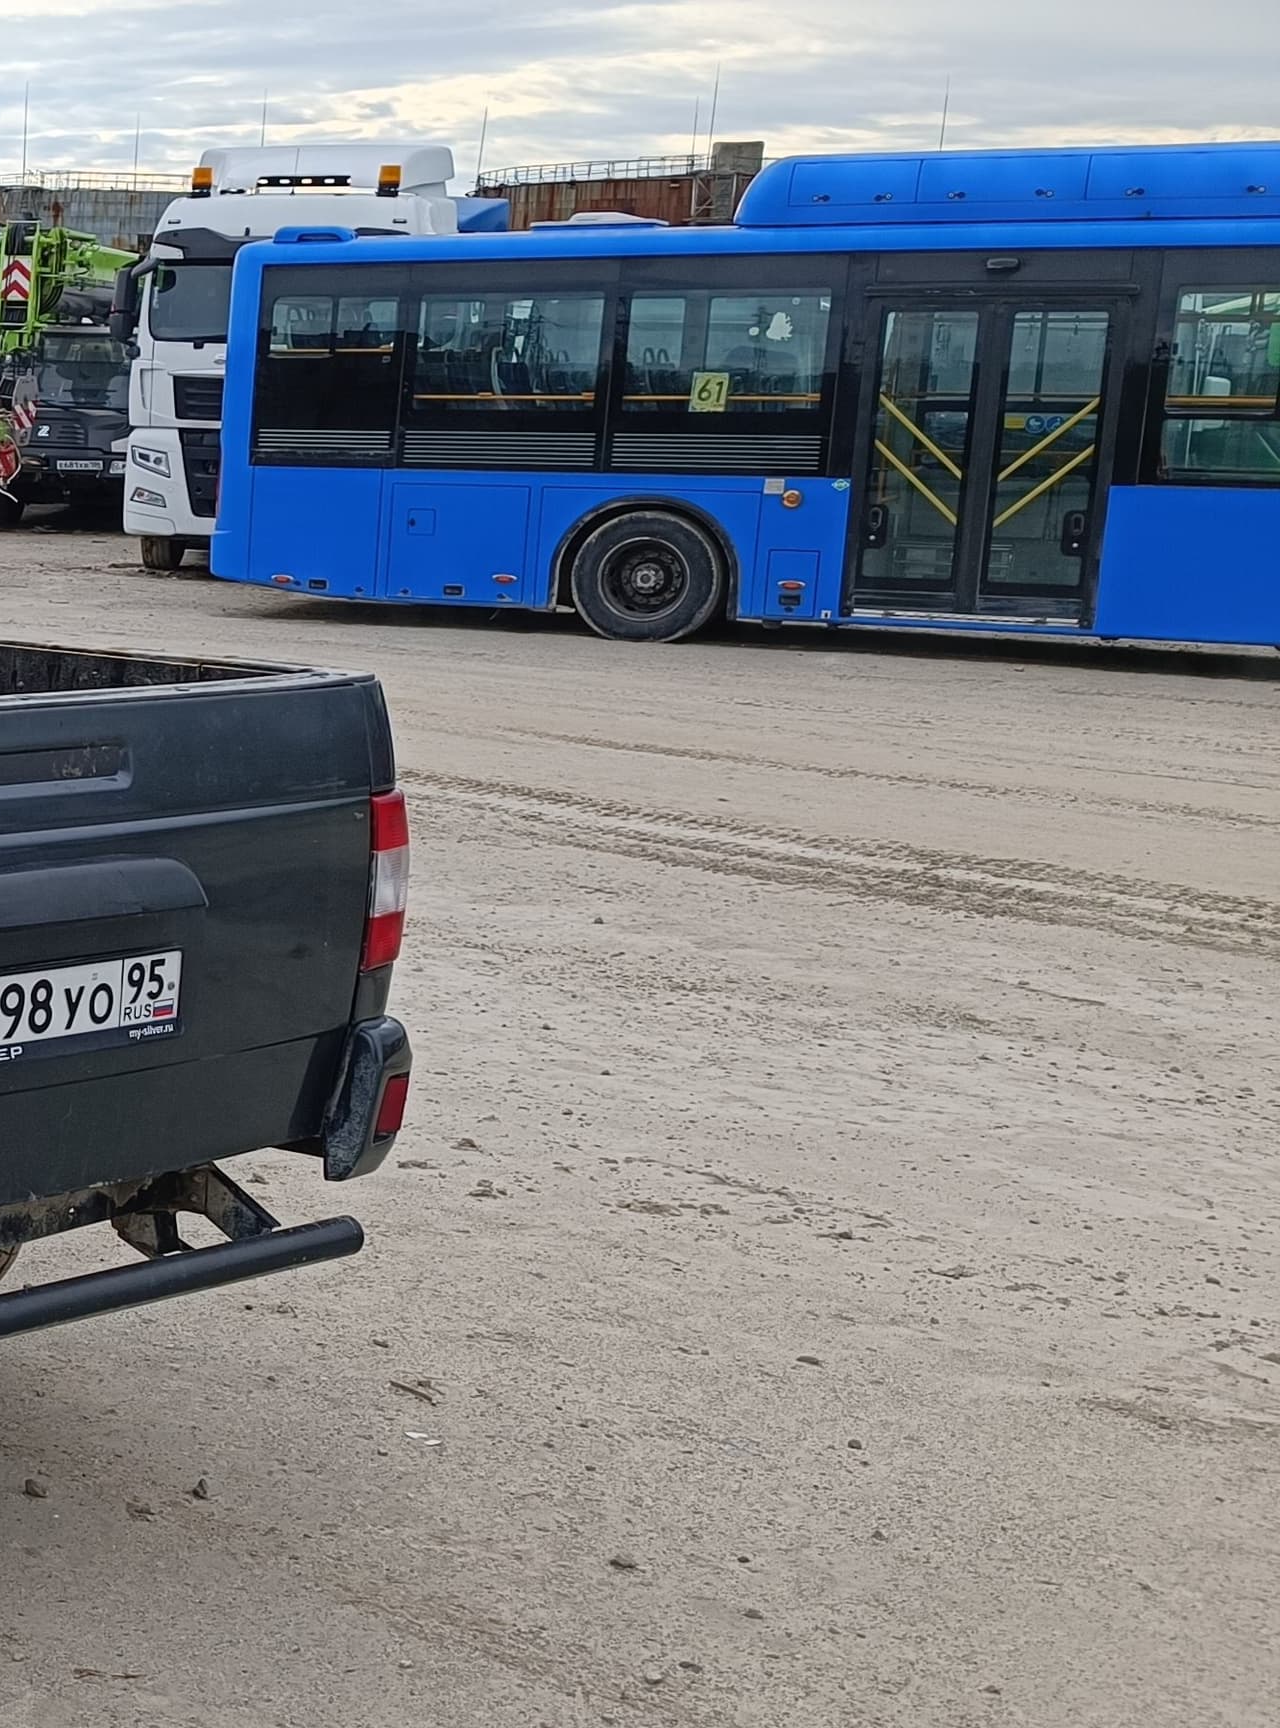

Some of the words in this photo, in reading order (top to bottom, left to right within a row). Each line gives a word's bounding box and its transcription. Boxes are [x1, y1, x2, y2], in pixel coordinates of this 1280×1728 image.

[697, 378, 725, 403] 61
[127, 958, 167, 1004] 95
[123, 1003, 153, 1022] RUS
